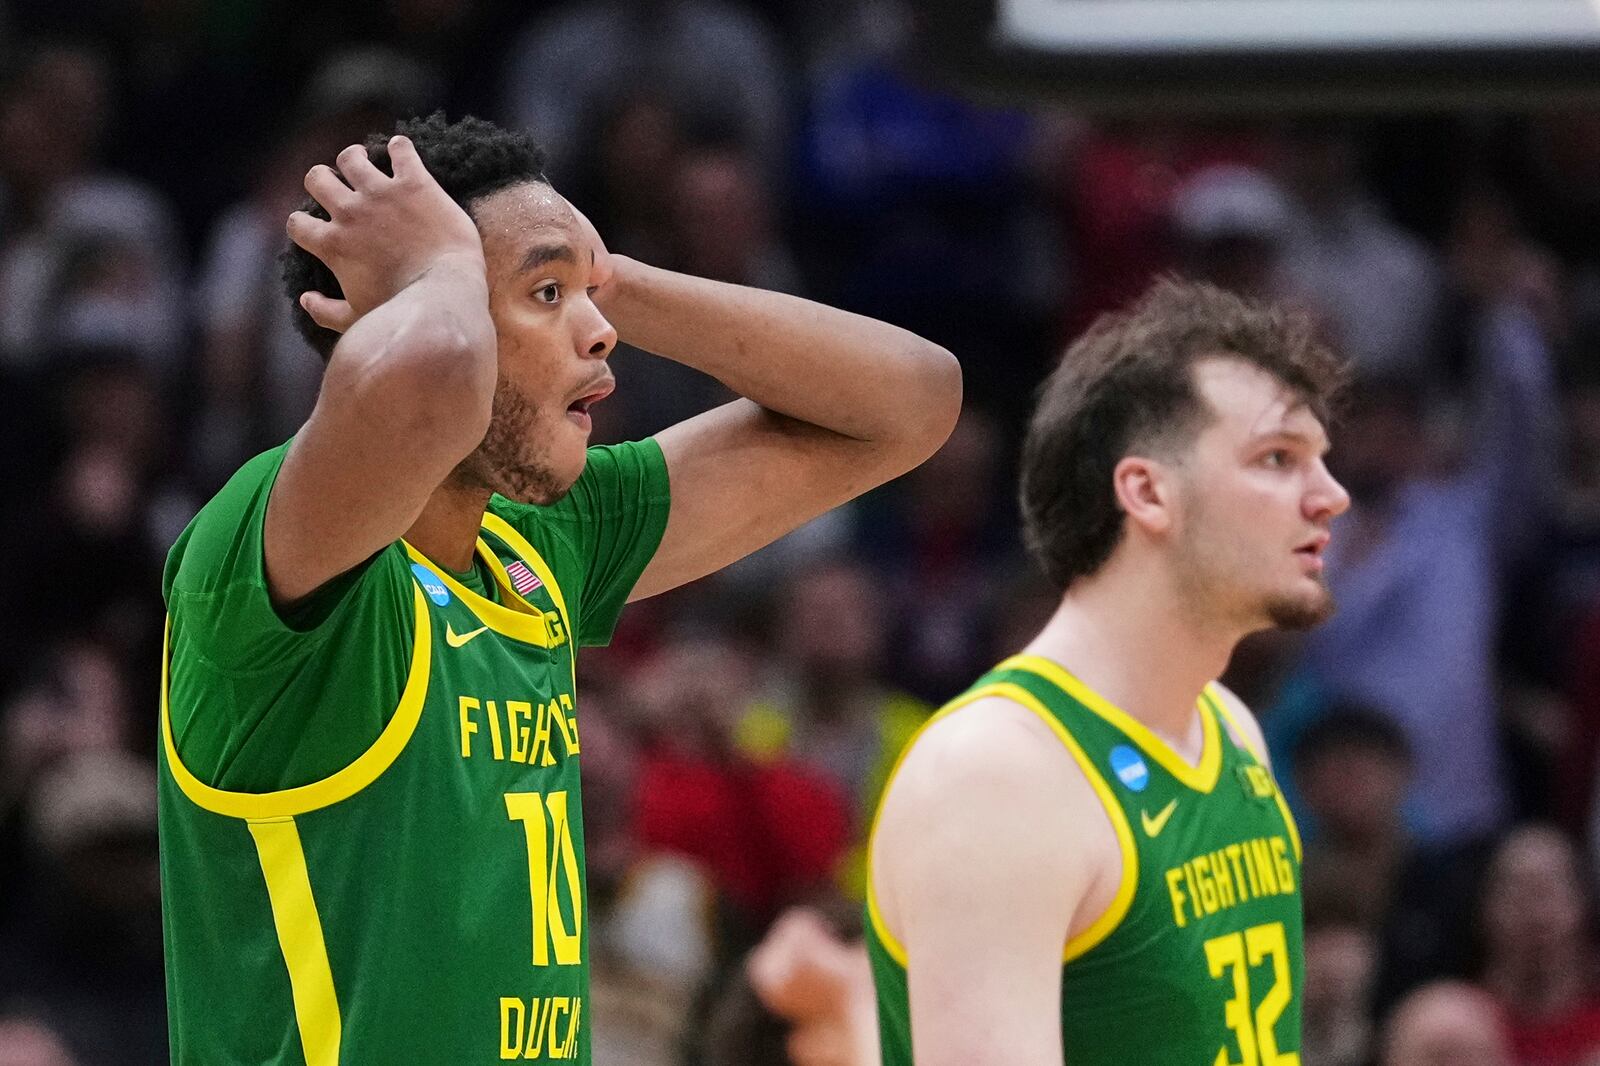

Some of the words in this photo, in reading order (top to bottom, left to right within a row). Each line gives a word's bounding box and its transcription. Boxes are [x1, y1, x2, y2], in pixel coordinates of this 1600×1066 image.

[504, 790, 582, 966] 10
[1165, 835, 1296, 928] FIGHTING
[1203, 921, 1301, 1066] 32
